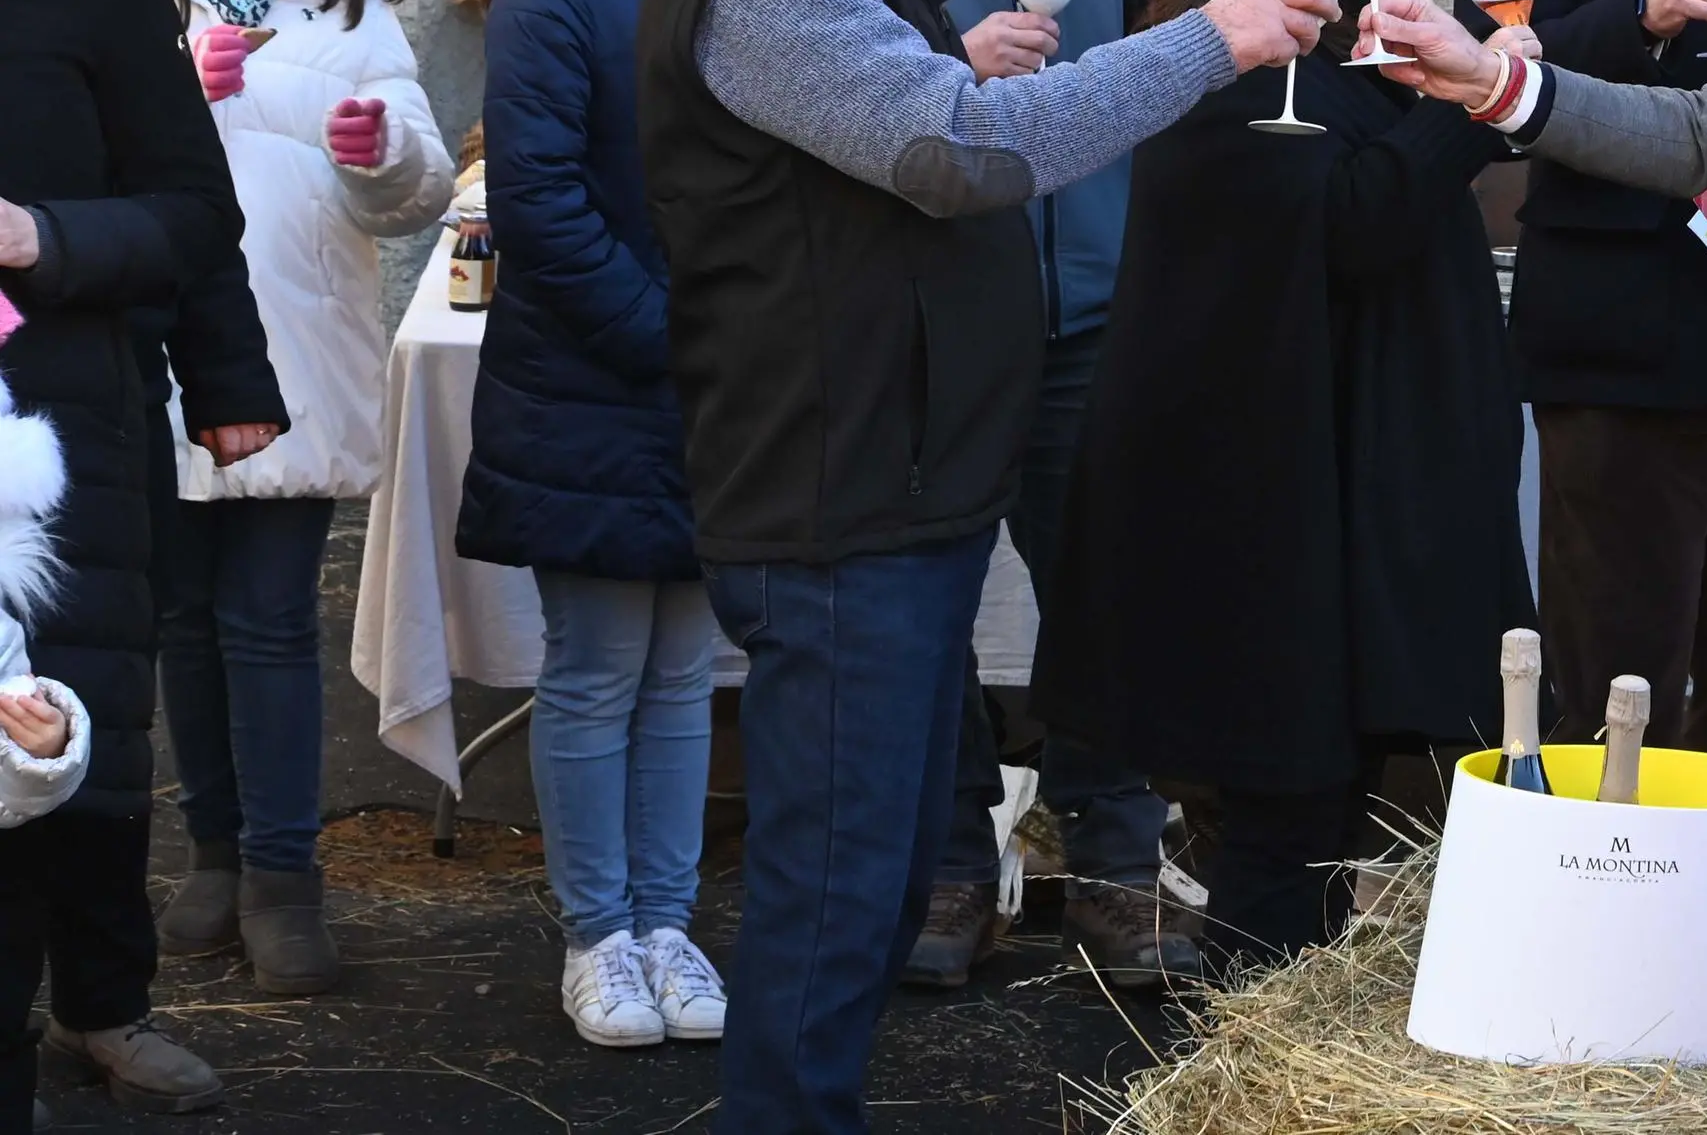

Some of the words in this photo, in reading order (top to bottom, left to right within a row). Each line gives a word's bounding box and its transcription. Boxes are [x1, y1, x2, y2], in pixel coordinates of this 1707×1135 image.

[1609, 837, 1632, 853] M
[1559, 854, 1580, 869] LA
[1585, 857, 1680, 878] MONTINA
